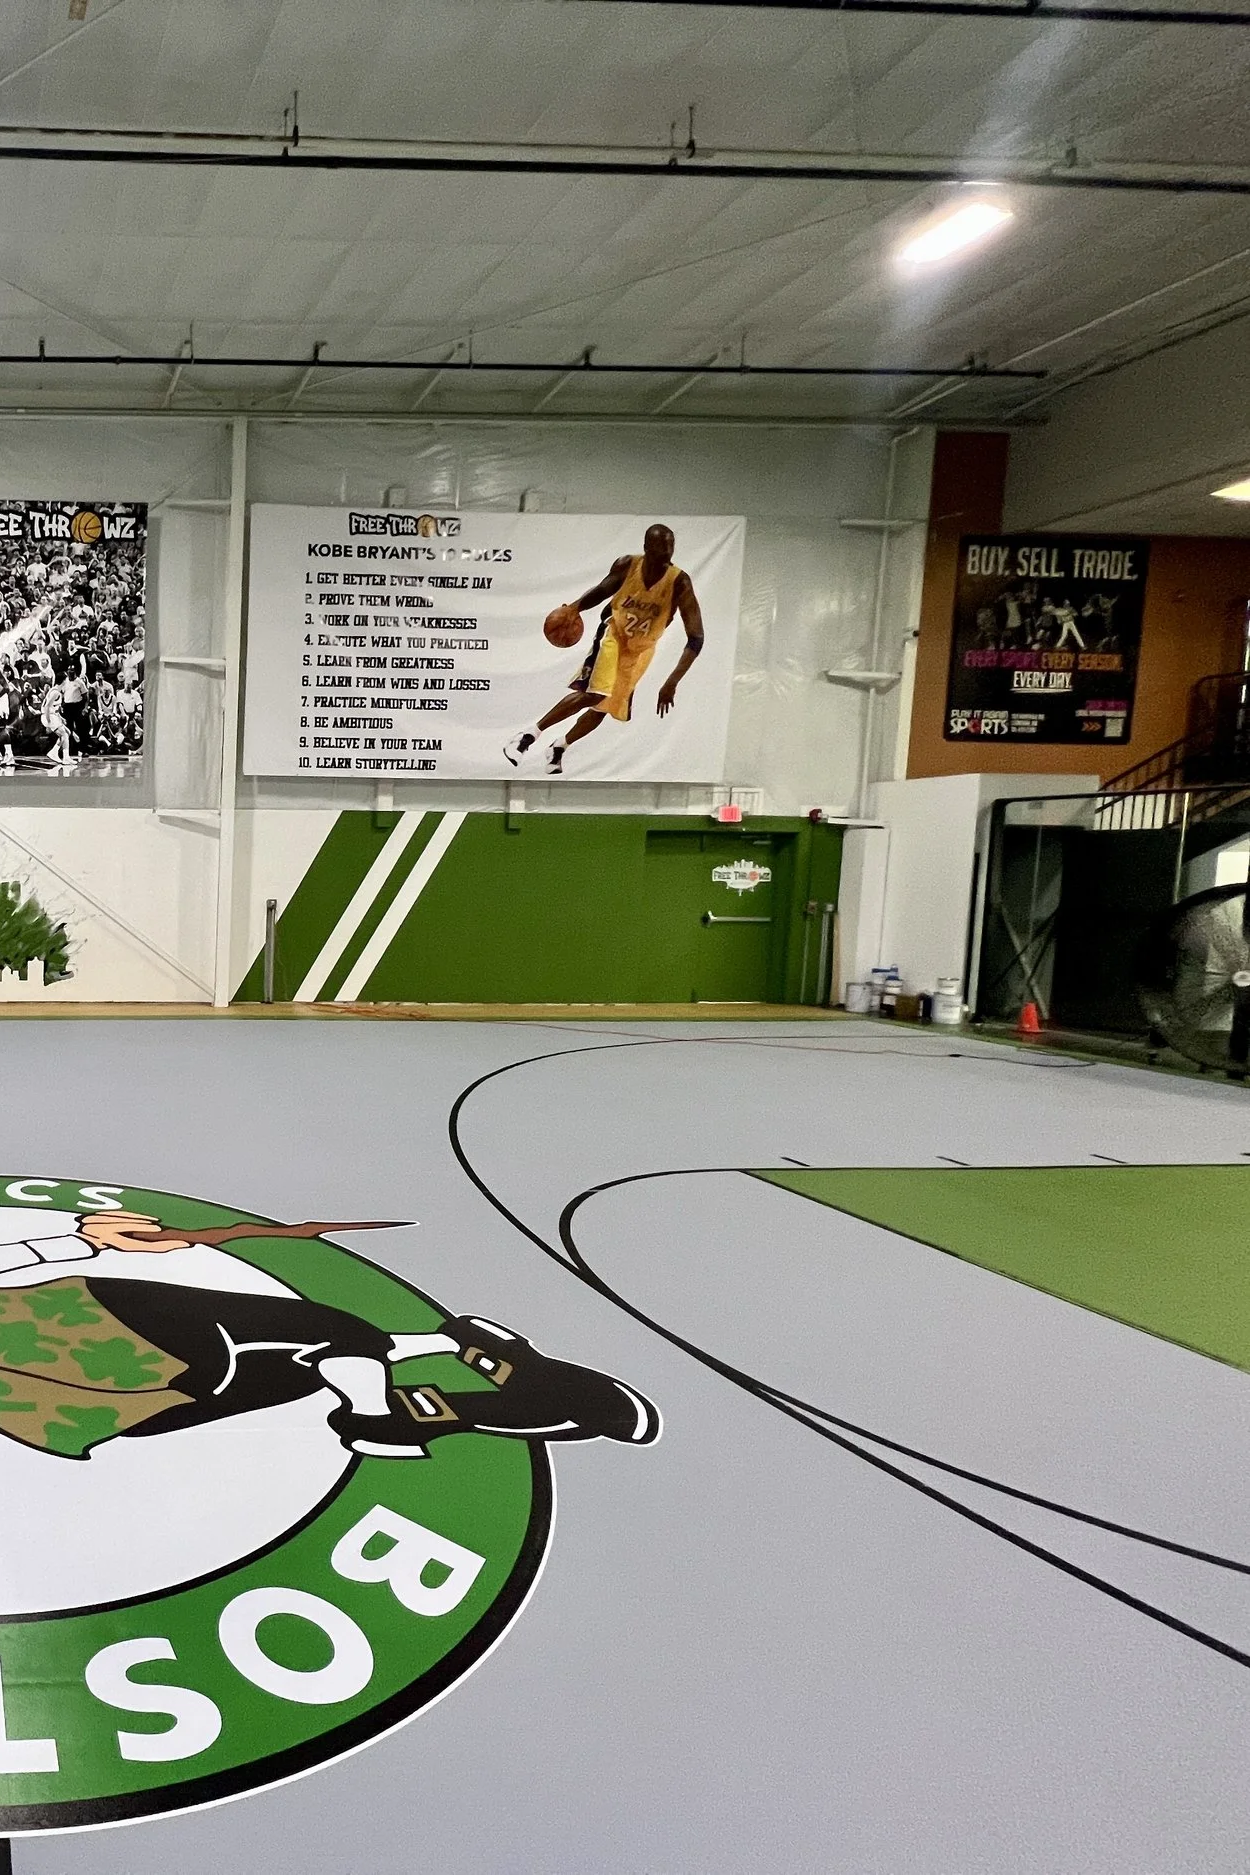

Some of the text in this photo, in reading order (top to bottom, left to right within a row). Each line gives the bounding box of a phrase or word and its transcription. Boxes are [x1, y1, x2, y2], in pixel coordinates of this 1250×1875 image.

[350, 513, 385, 535] FREE
[308, 544, 353, 558] KOBE
[357, 545, 436, 560] BRYANT'S
[966, 544, 1139, 581] BUY. SELL. TRADE.
[305, 572, 493, 589] 1. GET BETTER EVERY SINGLE DAY
[305, 594, 434, 608] 2. PROVE THEM WRONG
[305, 613, 314, 625] 3.
[354, 615, 369, 626] ON
[373, 616, 399, 627] YOUR
[404, 616, 477, 629] WEAKNESSES
[624, 612, 652, 638] 24
[304, 634, 313, 646] 4.
[371, 636, 402, 648] WHAT
[406, 637, 426, 648] YOU
[430, 638, 489, 650] PRACTICED
[302, 655, 454, 669] 5. LEARN FROM GREATNESS
[1040, 652, 1076, 670] EVERY
[302, 676, 490, 690] 6. LEARN FROM WINS AND LOSSES
[1013, 670, 1073, 689] EVERY DAY.
[302, 696, 448, 710] 7. PRACTICE MINDFULNESS
[951, 709, 972, 719] PLAY
[973, 710, 982, 719] IT
[300, 717, 393, 729] 8. BE AMBITIOUS
[949, 719, 1009, 735] SPORTS
[299, 737, 442, 750] 9. BELIEVE IN YOUR TEAM
[299, 757, 436, 770] 10. LEARN STORYTELLING
[713, 870, 732, 880] FREE
